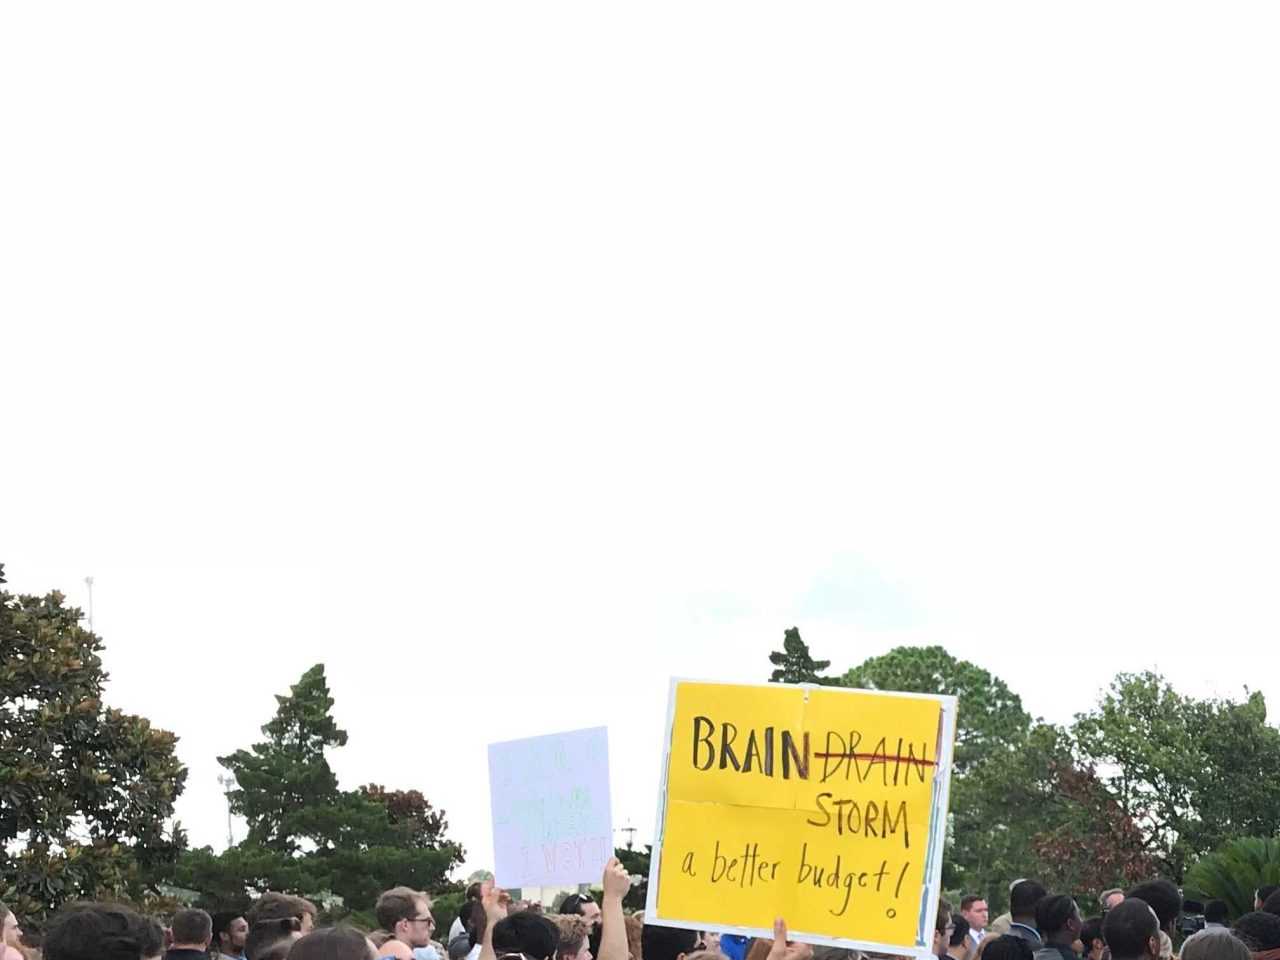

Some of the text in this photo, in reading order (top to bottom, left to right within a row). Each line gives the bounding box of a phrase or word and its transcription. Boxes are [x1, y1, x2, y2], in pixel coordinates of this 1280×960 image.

[692, 715, 936, 787] BRAIN DRAIN
[807, 792, 910, 849] STORM
[681, 840, 911, 919] a better budget!
